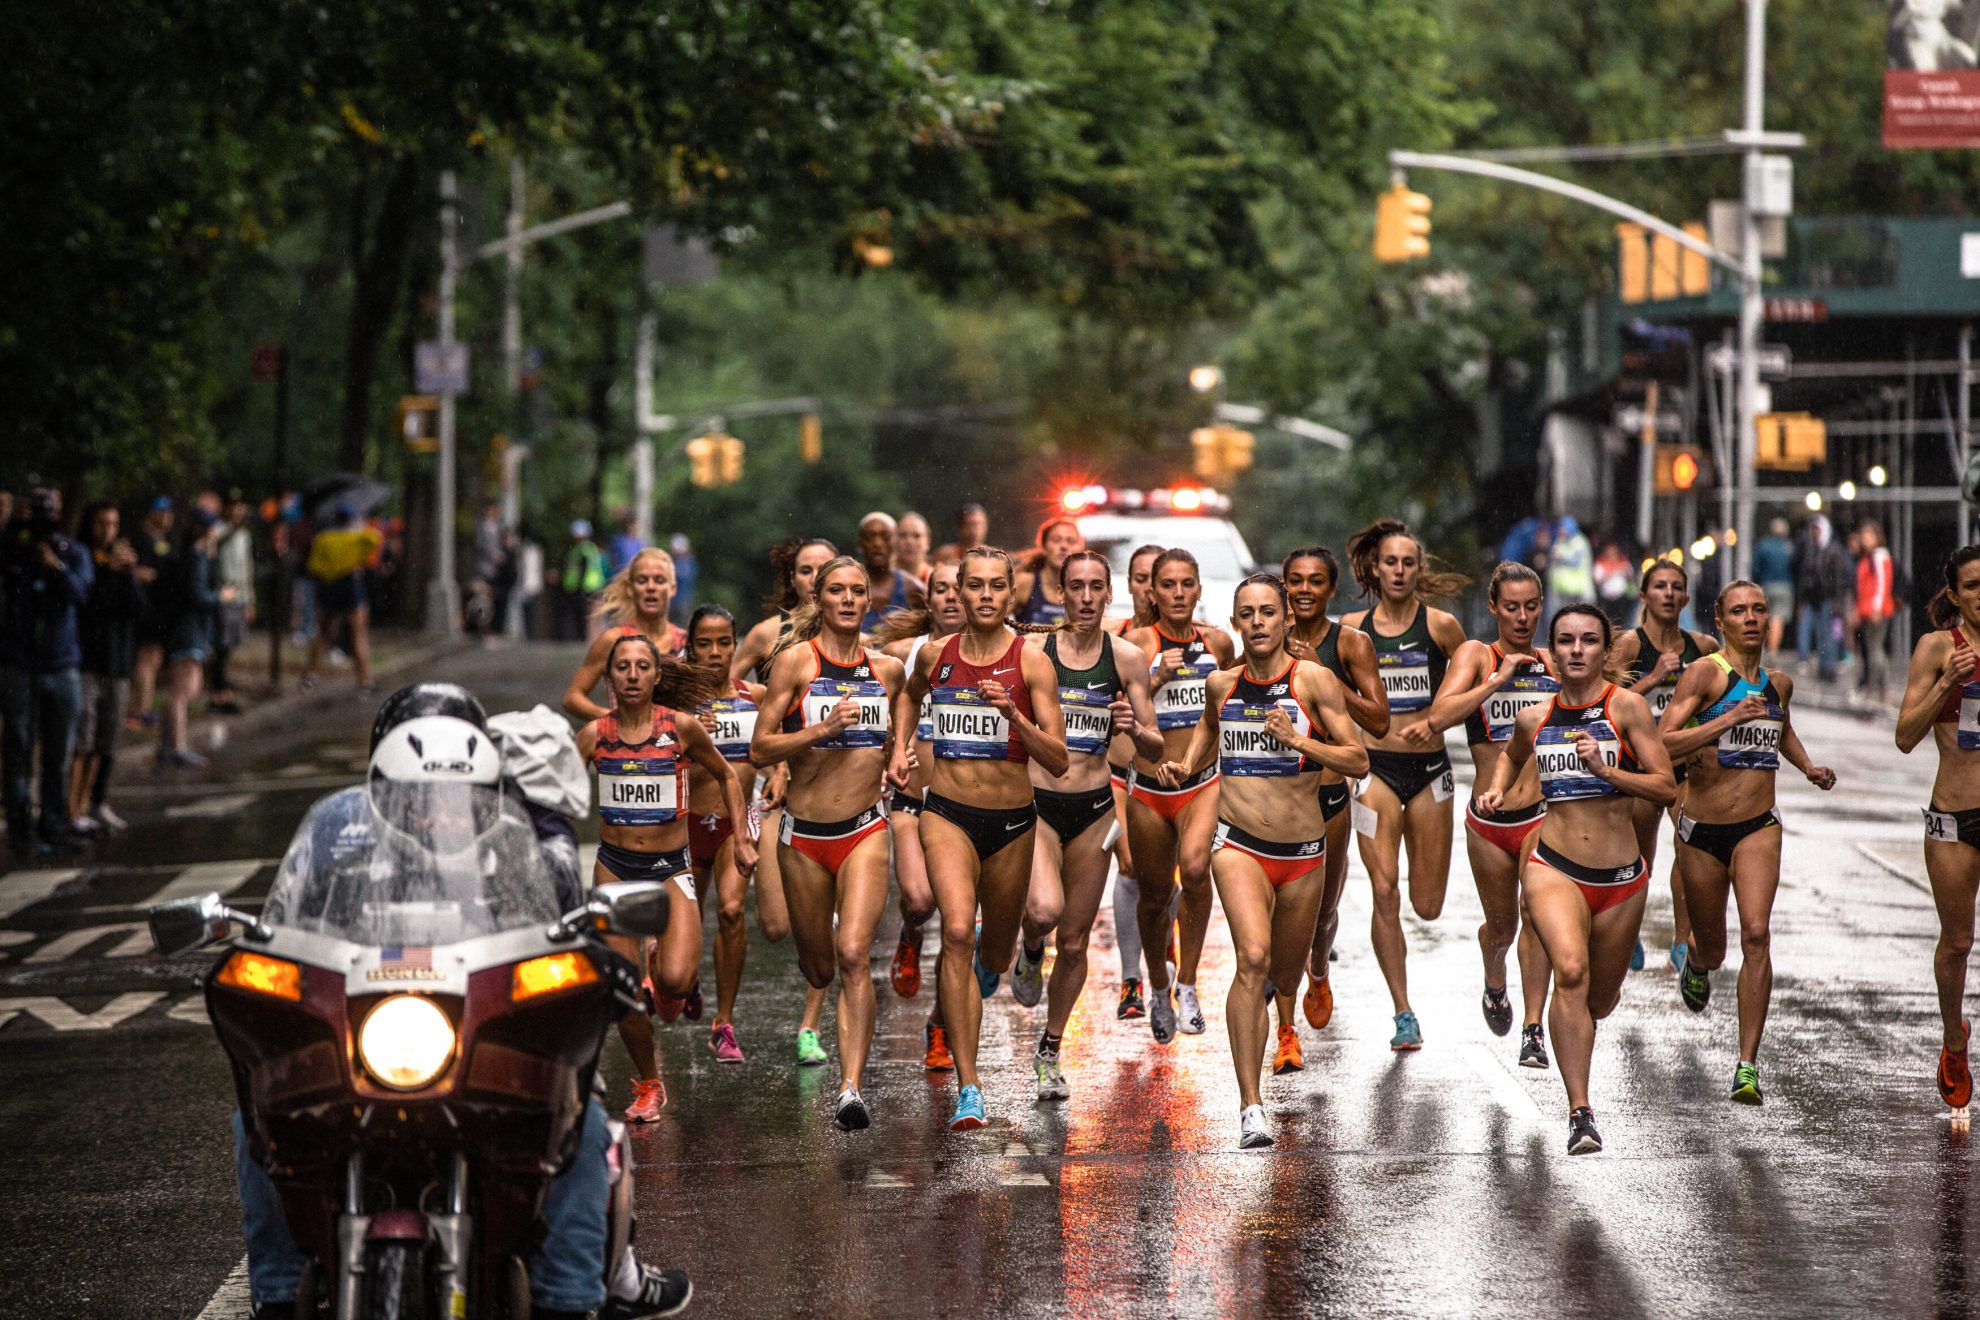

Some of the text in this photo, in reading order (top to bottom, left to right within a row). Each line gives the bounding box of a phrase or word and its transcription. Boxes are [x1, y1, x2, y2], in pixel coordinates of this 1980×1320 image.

[820, 705, 880, 724] CRN
[1490, 700, 1543, 719] COU
[939, 713, 1000, 736] QUIGLEY
[1442, 772, 1454, 793] 48
[612, 783, 660, 803] LIPARI
[1925, 814, 1945, 838] 34
